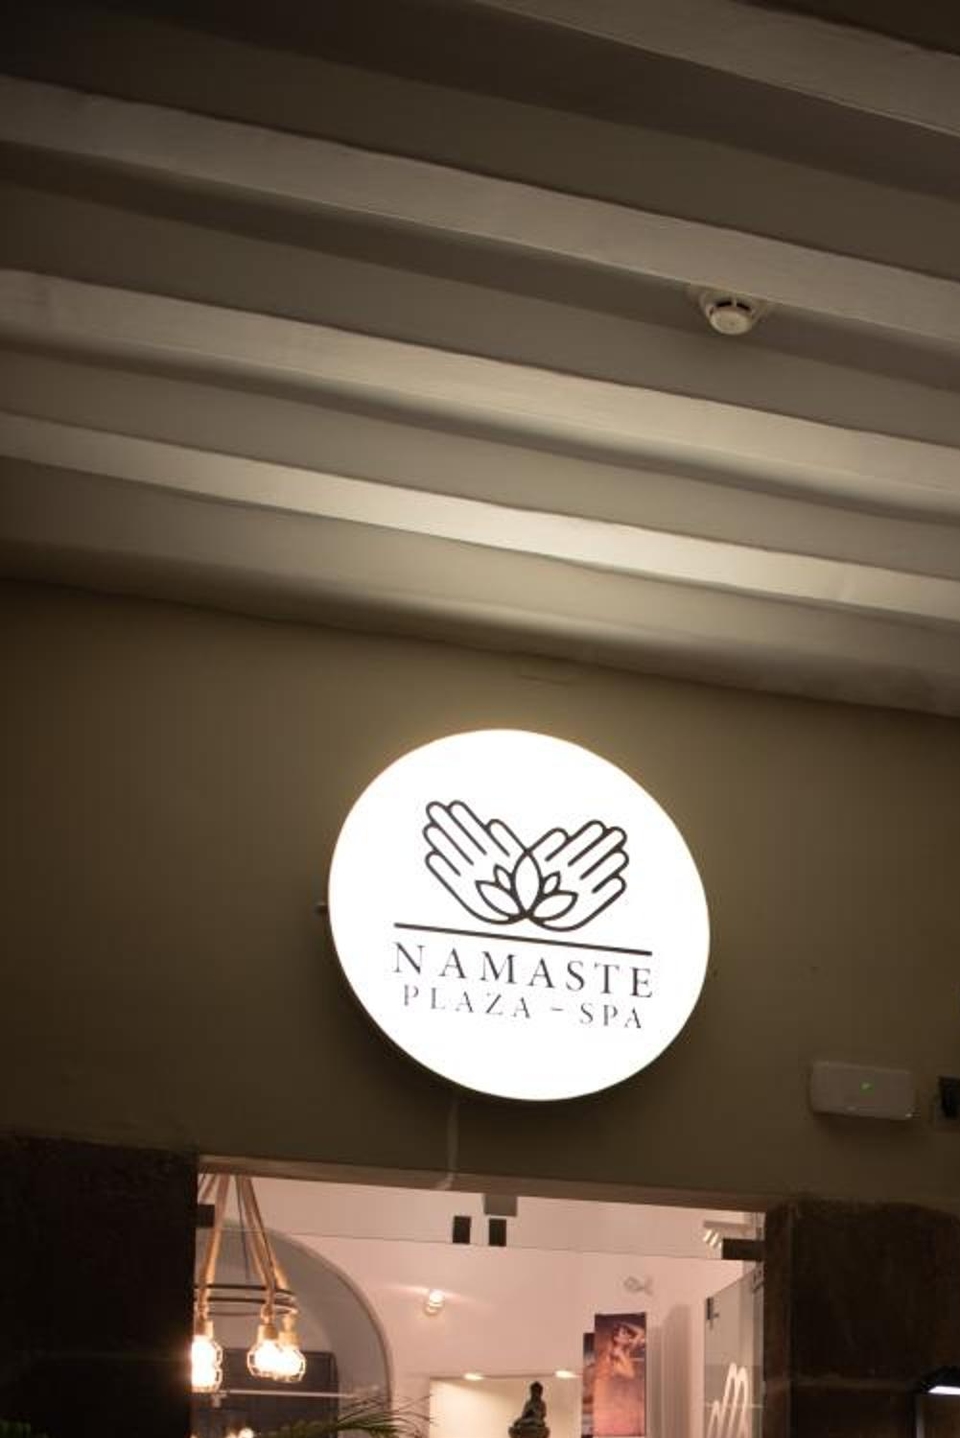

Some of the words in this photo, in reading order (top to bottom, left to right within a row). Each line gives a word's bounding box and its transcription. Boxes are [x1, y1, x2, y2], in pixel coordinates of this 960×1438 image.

[392, 942, 653, 998] NAMASTE
[403, 984, 531, 1019] PLAZA
[579, 1002, 642, 1029] SPA
